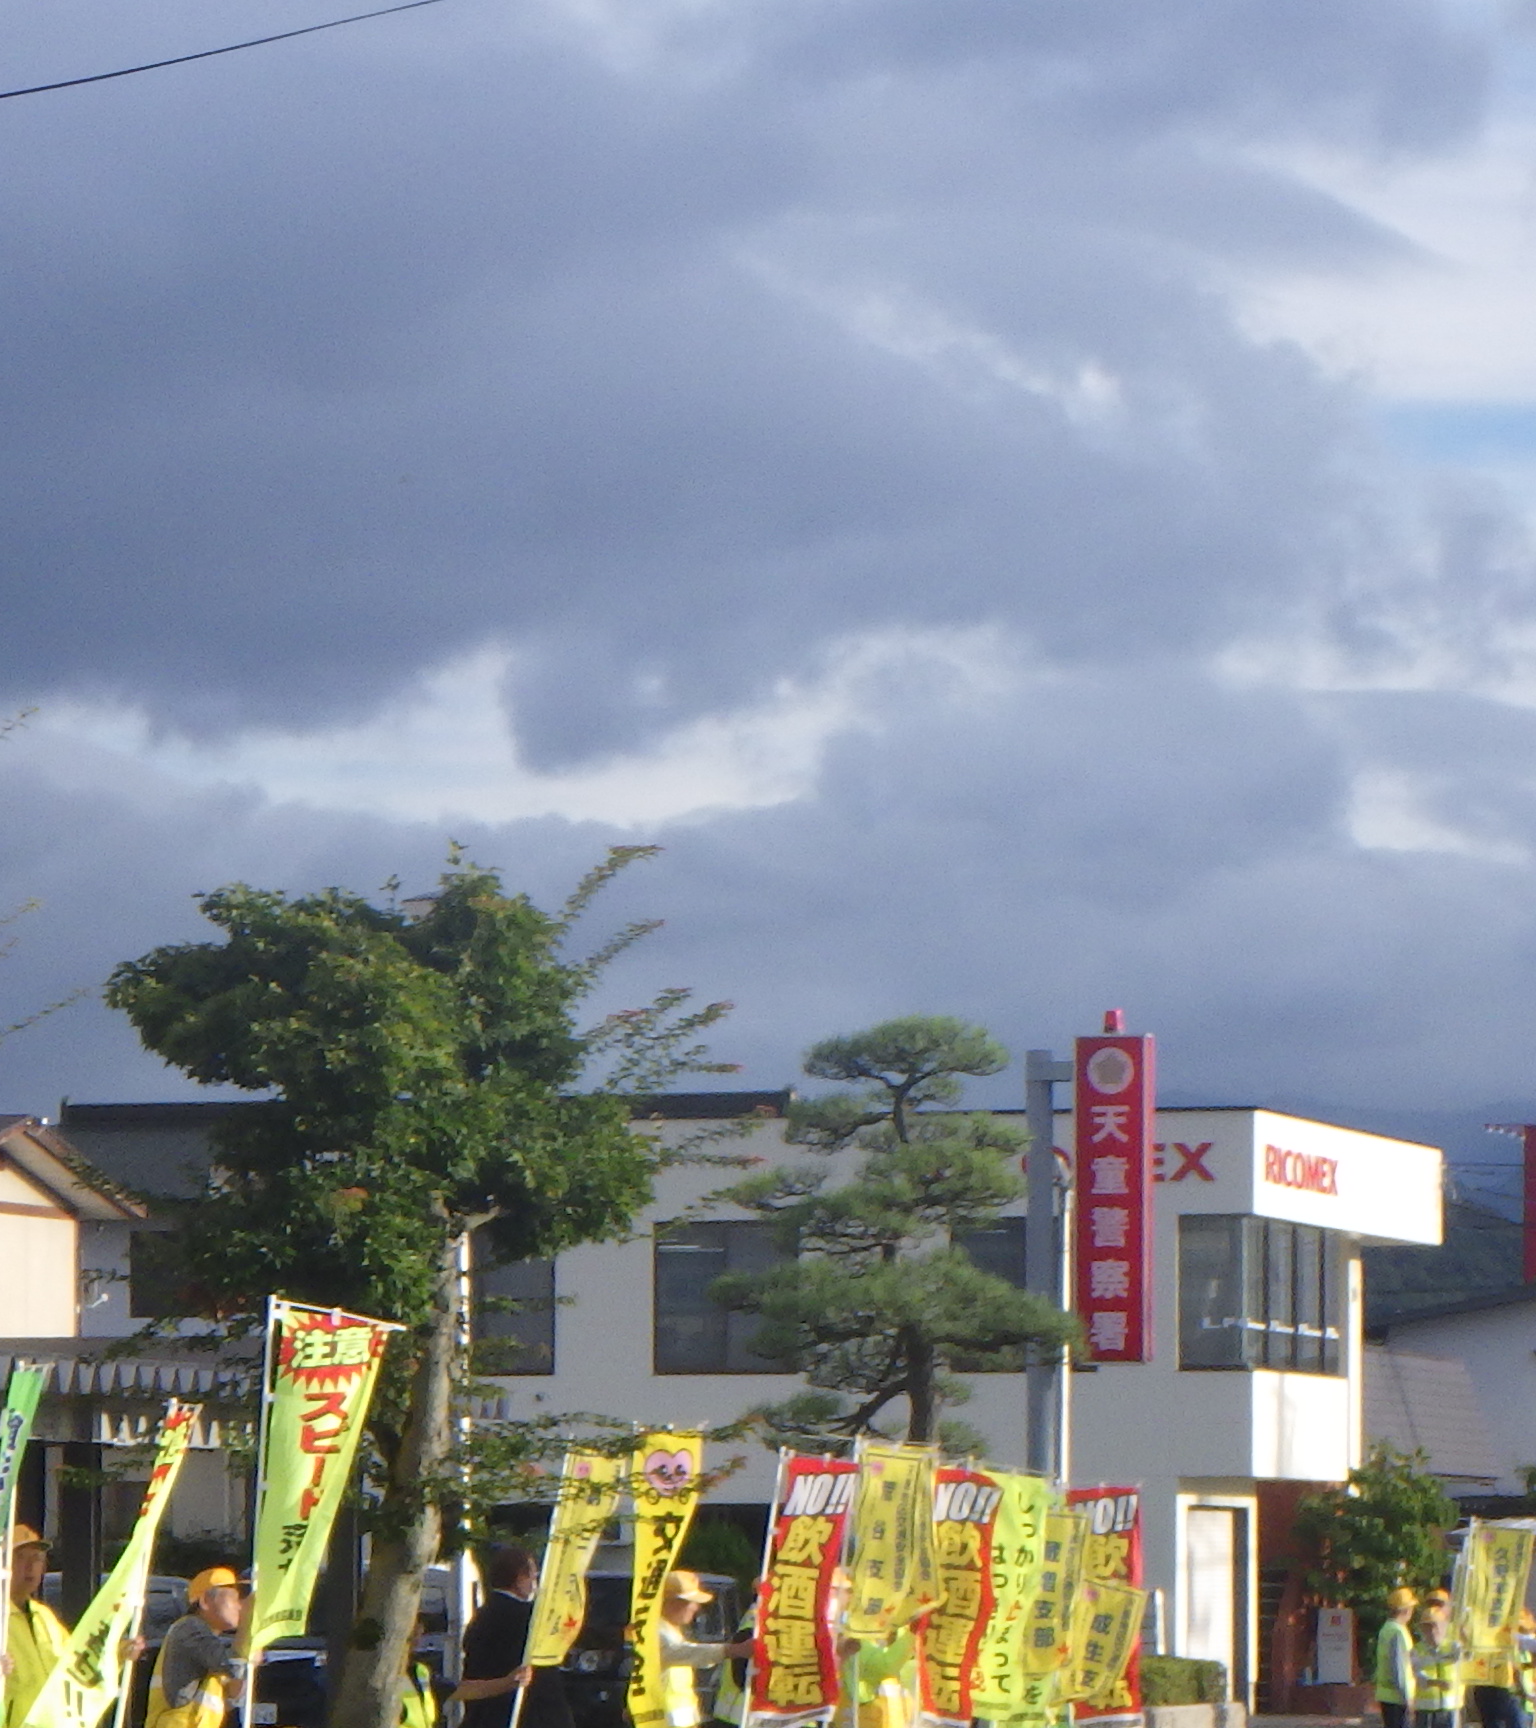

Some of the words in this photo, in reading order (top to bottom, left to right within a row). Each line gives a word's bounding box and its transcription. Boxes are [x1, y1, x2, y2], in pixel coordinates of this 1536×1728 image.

[1090, 1105, 1130, 1352] 天童警察署
[1265, 1144, 1339, 1196] RICOMEX
[291, 1326, 373, 1369] 注意
[764, 1515, 834, 1706] 飲酒運転
